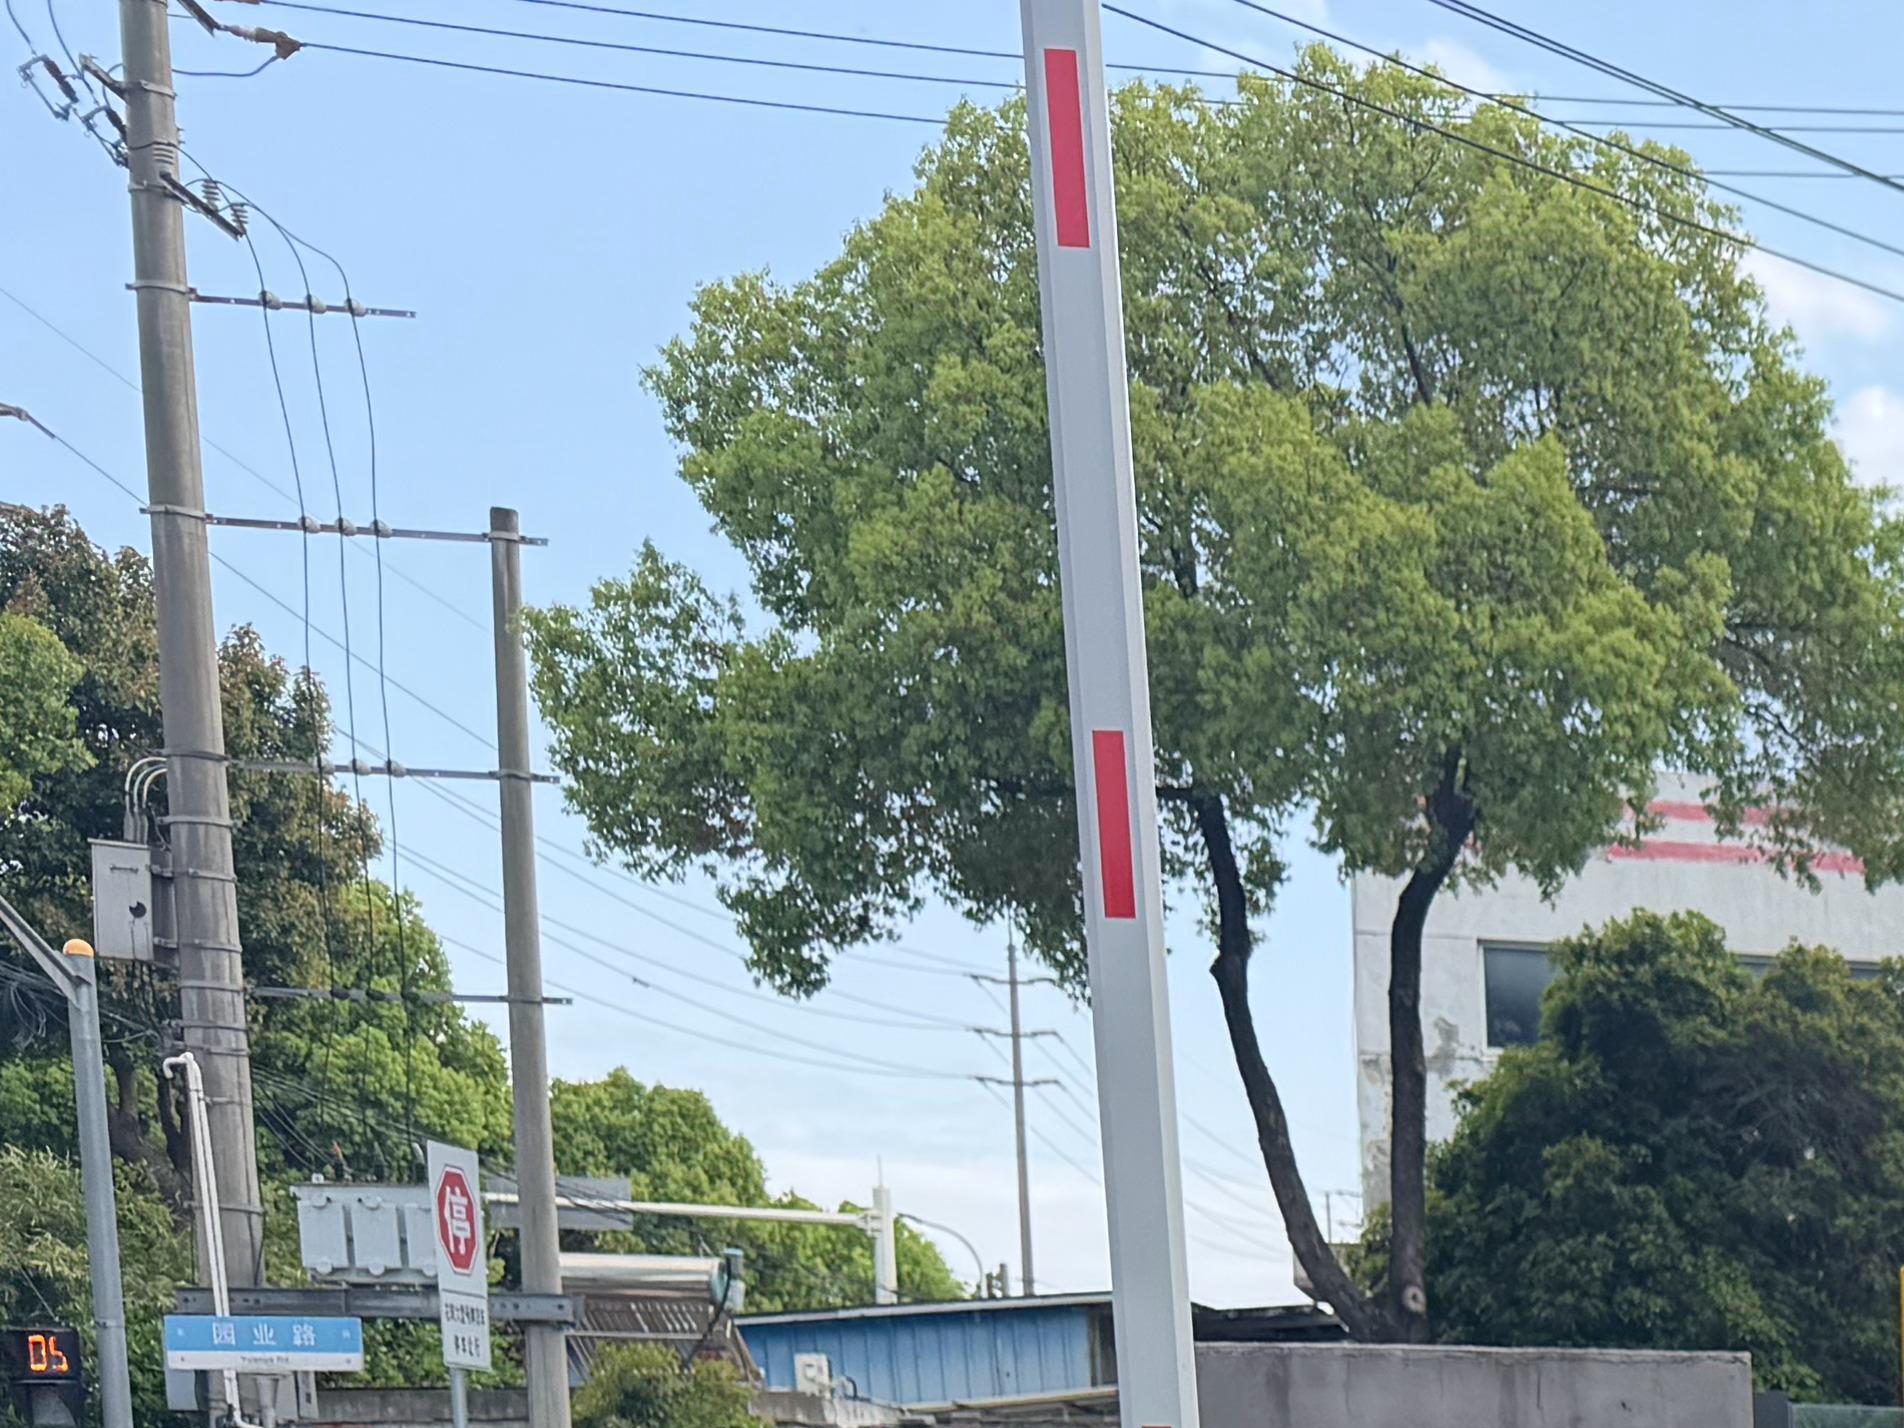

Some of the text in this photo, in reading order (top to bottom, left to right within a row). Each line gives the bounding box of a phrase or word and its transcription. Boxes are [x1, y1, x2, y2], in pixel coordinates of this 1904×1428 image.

[444, 1185, 471, 1255] 停
[212, 1322, 316, 1346] 园业路
